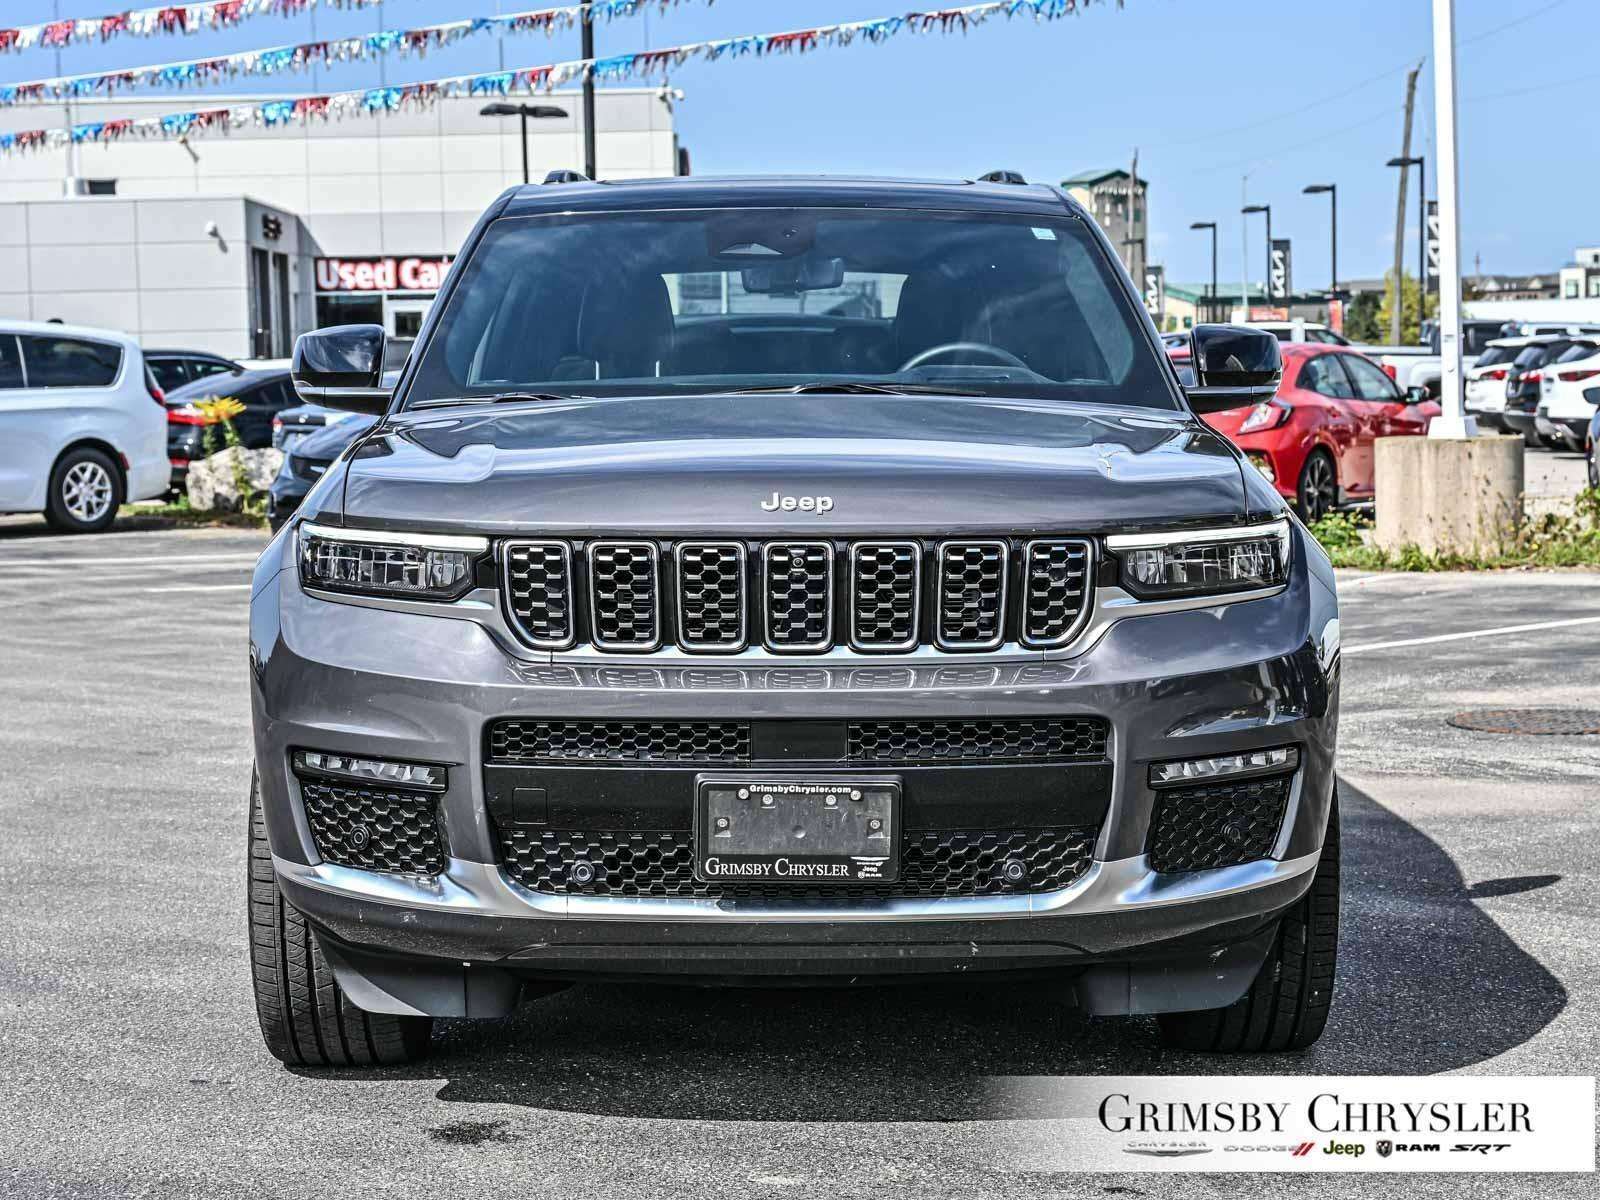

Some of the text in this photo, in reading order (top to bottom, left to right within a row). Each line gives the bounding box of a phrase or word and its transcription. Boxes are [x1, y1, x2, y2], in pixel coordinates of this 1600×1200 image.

[316, 258, 397, 289] Used
[760, 491, 834, 516] Jeep
[749, 784, 852, 794] GrimsbyChrysler.com
[705, 857, 850, 877] GRIMSBY CHRYSLER
